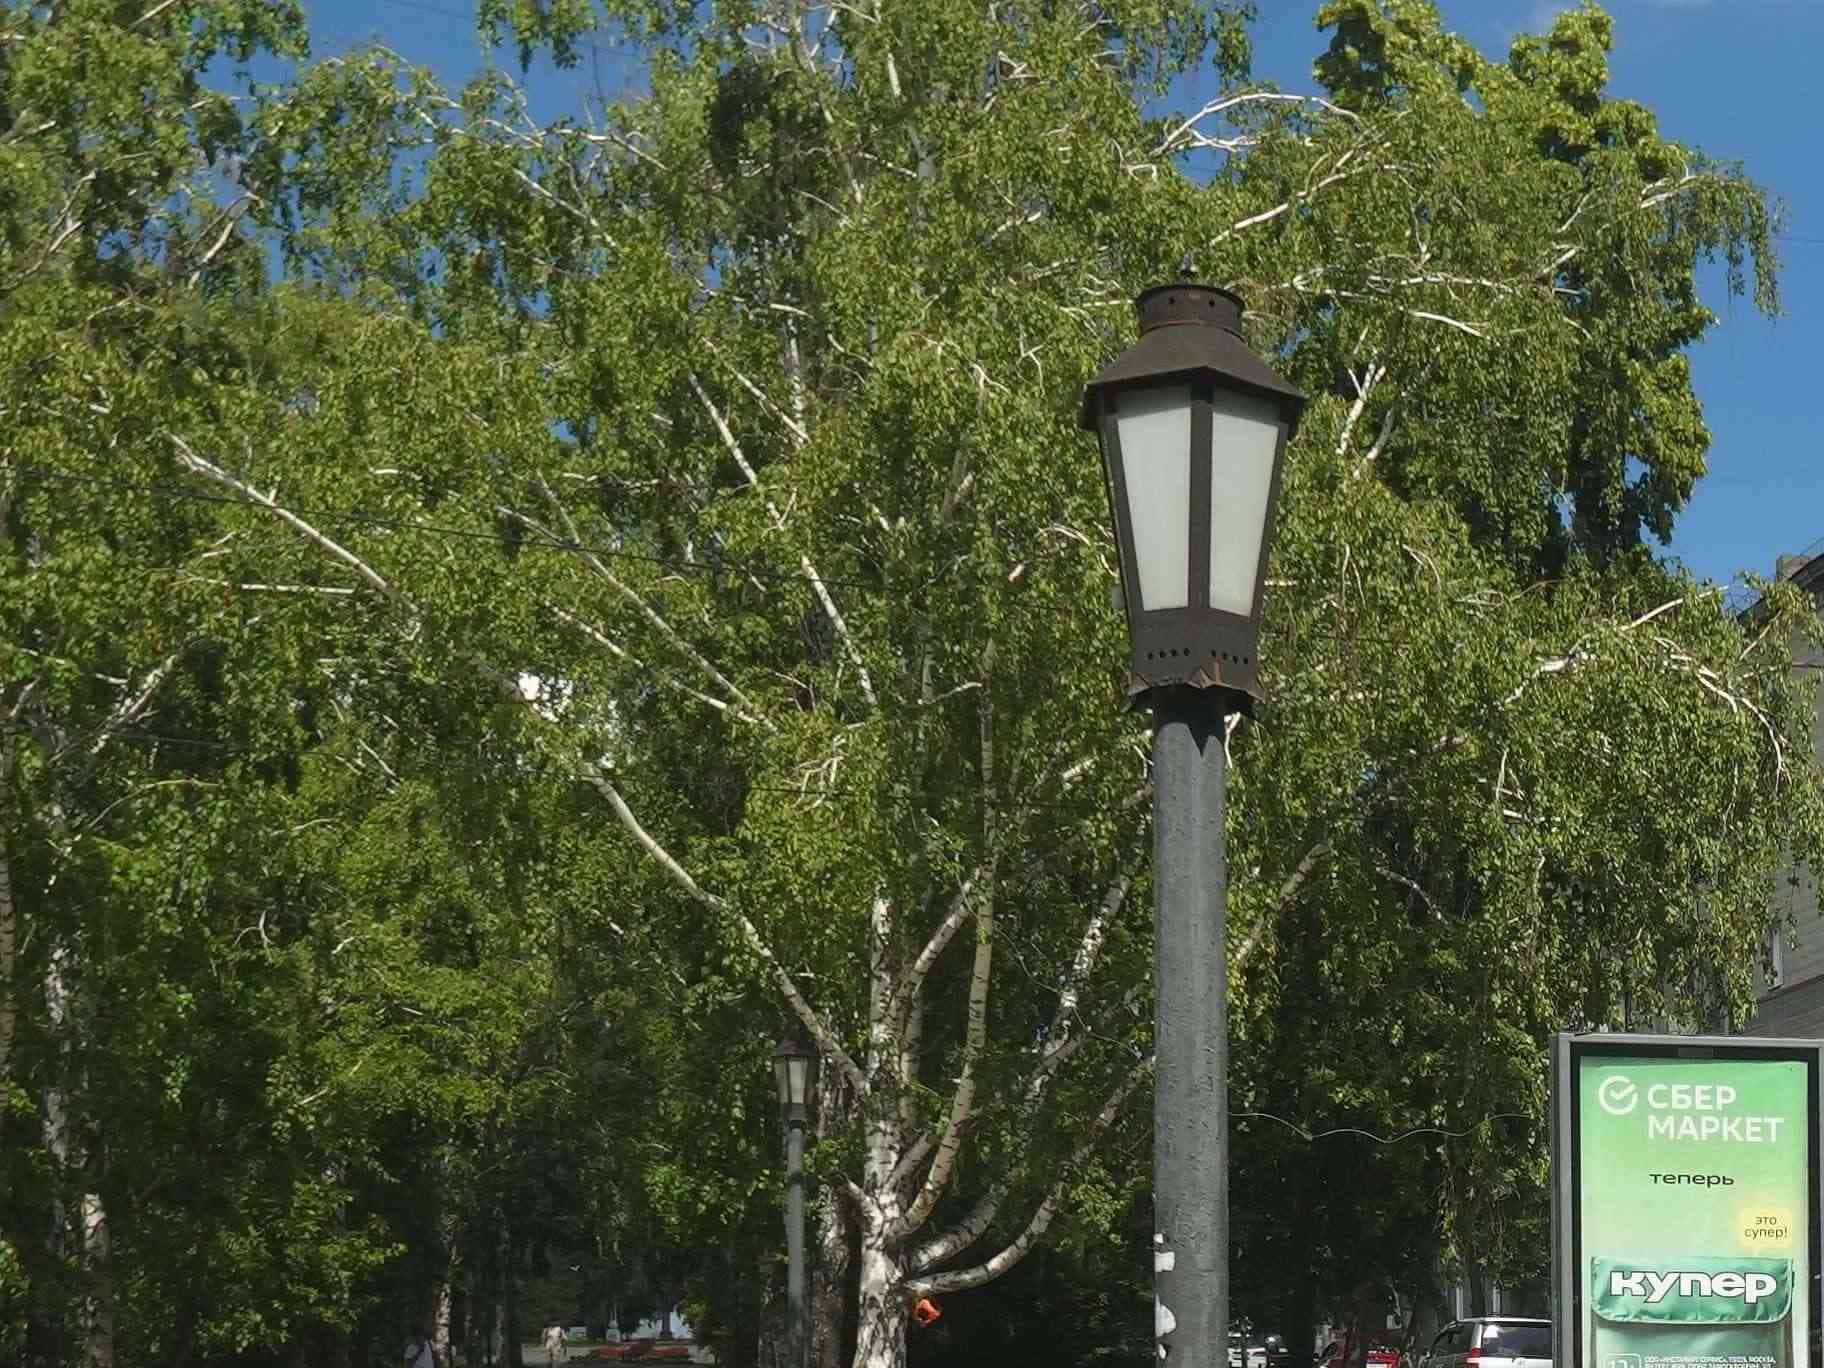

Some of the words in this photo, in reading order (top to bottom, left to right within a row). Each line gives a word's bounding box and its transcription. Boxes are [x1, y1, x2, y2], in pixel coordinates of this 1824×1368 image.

[1647, 1083, 1737, 1110] СБЕР
[1647, 1114, 1785, 1143] МАРКЕТ
[1649, 1173, 1735, 1189] теперь
[1754, 1216, 1778, 1226] это
[1744, 1227, 1789, 1243] супер!
[1609, 1270, 1778, 1305] купер
